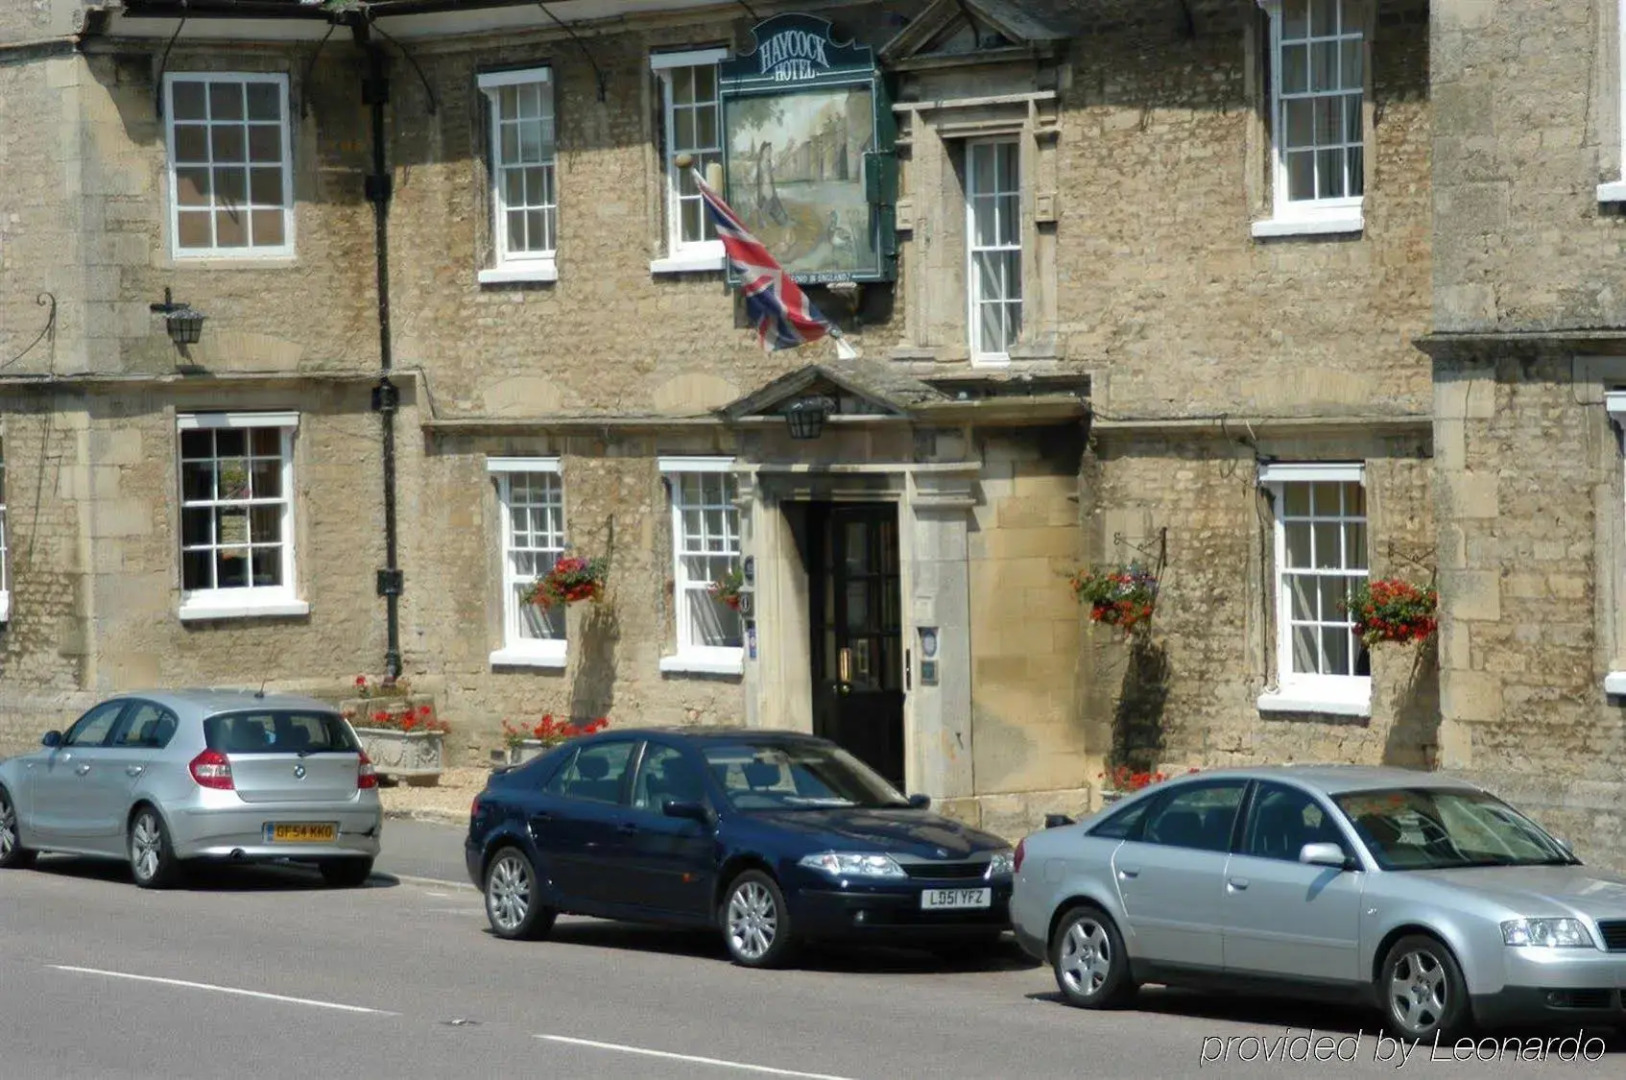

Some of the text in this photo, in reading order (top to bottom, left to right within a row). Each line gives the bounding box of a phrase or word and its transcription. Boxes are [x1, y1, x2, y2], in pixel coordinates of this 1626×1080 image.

[759, 30, 830, 74] HAYCOCK
[774, 59, 816, 82] HOTEL
[961, 890, 984, 904] YFZ
